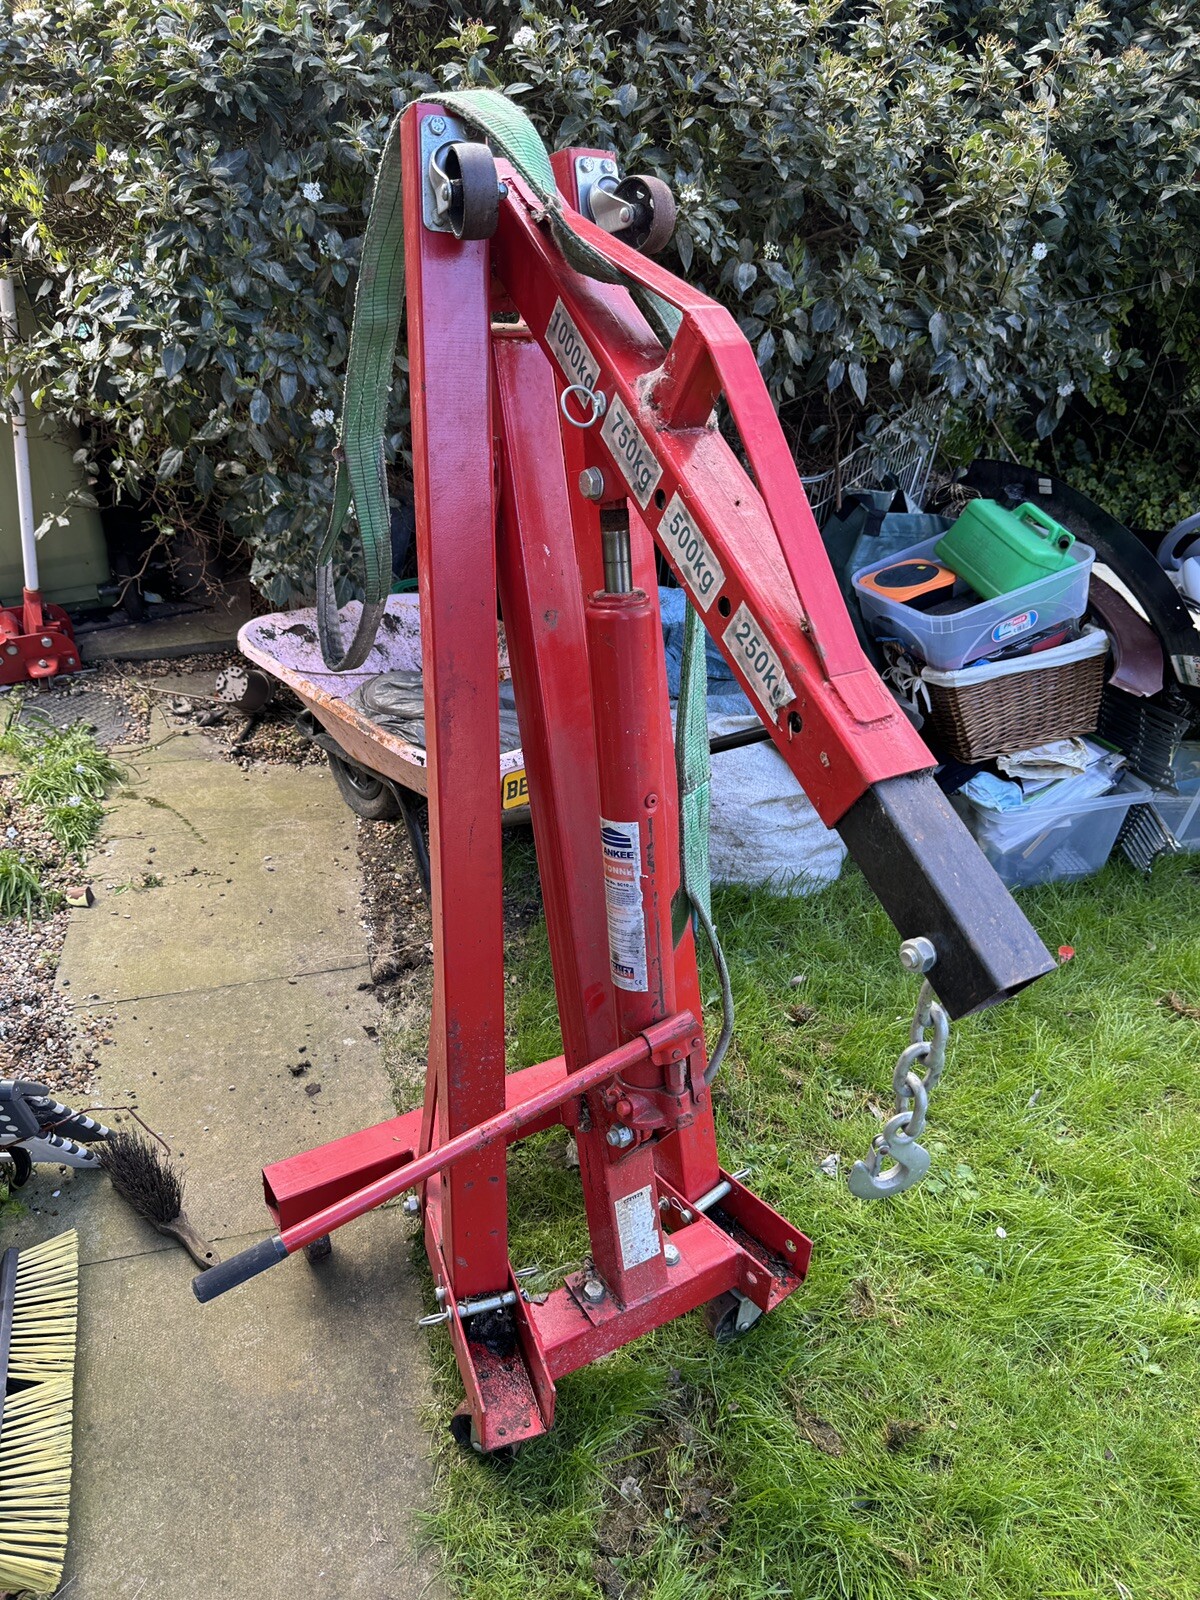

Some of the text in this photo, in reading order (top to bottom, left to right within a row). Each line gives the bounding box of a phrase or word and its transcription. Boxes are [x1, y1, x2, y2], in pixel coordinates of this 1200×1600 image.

[553, 312, 594, 397] 1000kg
[611, 411, 651, 492] 750kg
[670, 512, 715, 595] 500kg
